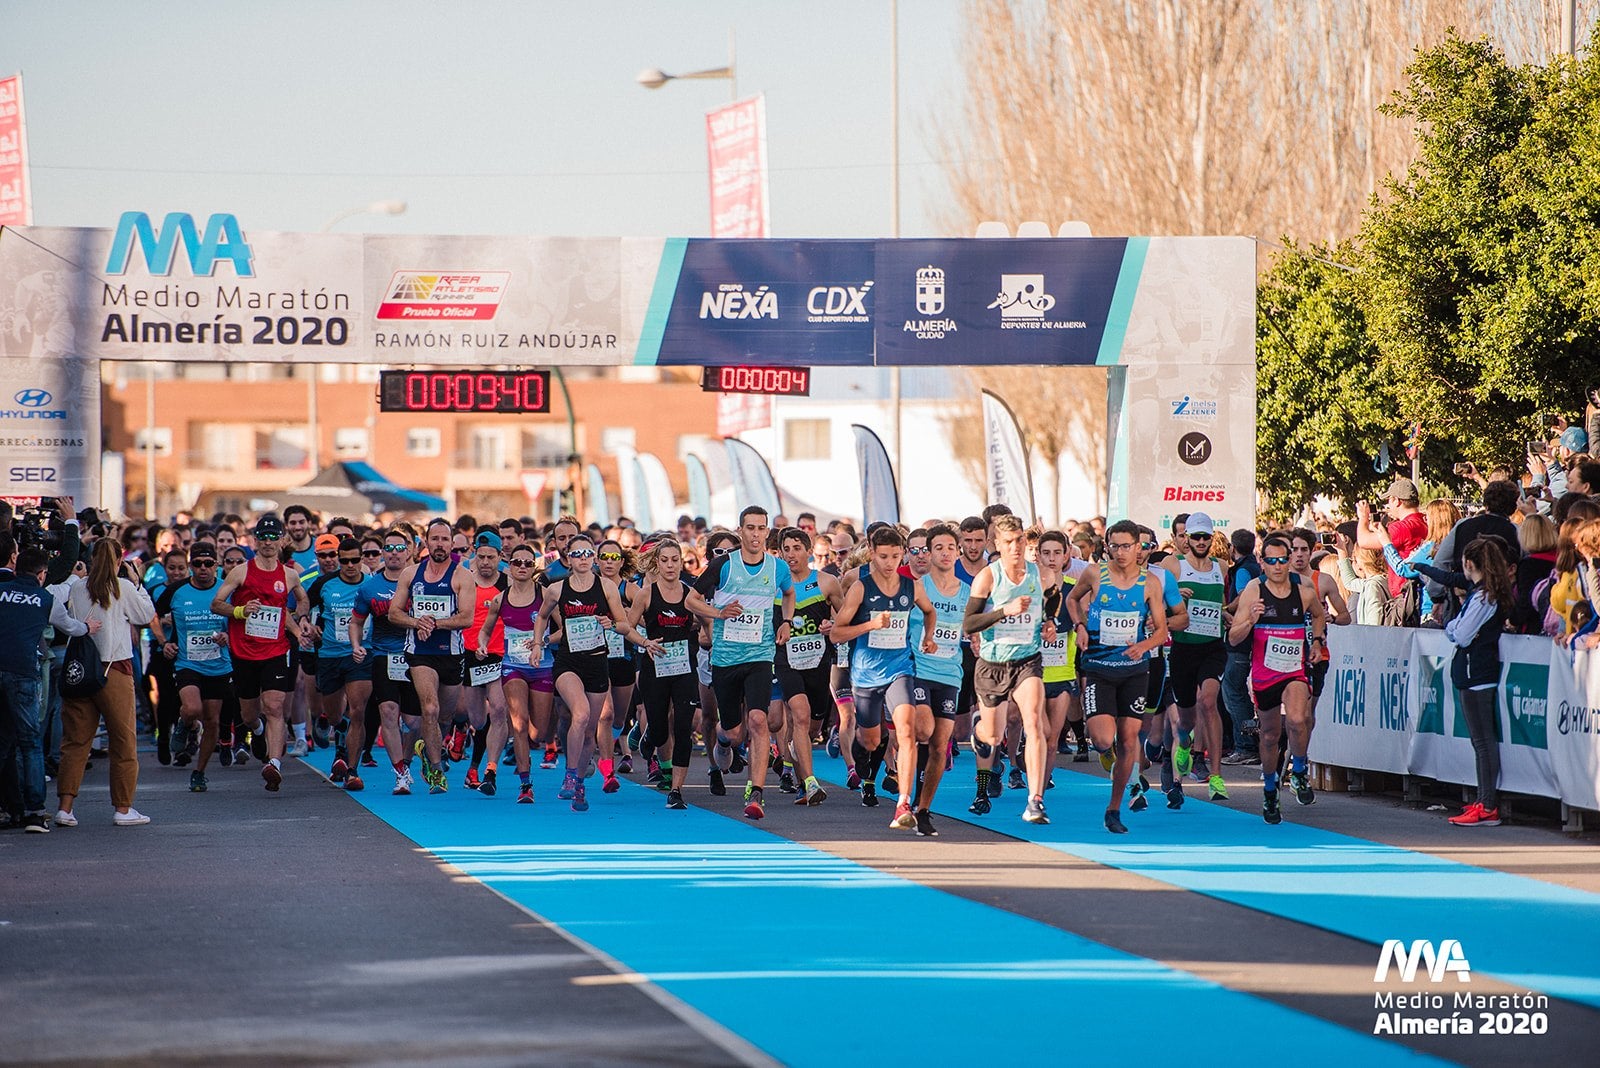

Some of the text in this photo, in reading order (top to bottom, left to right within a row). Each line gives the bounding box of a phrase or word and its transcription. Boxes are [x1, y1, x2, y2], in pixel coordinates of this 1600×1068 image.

[439, 275, 481, 285] RFEA
[102, 282, 350, 311] Medio Maratón
[700, 287, 779, 319] NEXA
[807, 281, 875, 315] CDX
[402, 307, 477, 317] Prueba Oficial
[101, 314, 348, 346] Almería 2020
[904, 318, 958, 332] ALMERÍA
[1001, 321, 1041, 329] DEPORTES
[1042, 321, 1053, 329] DE
[375, 330, 617, 349] RAMÓN RUIZ ANDÚJAR
[917, 332, 945, 340] CIUDAD
[0, 410, 67, 419] HYUNDAI
[10, 468, 57, 482] SER
[1163, 486, 1225, 502] Blanes
[0, 591, 41, 607] NEXA
[417, 602, 445, 611] 5601
[931, 601, 958, 613] erja
[1192, 606, 1219, 619] 5472
[251, 609, 277, 622] 5111
[571, 620, 599, 634] 5847
[1105, 617, 1136, 628] 6109
[932, 628, 958, 640] 965
[665, 646, 686, 659] 582
[791, 640, 822, 653] 5688
[1272, 644, 1300, 655] 6088
[392, 656, 406, 664] 50
[475, 662, 502, 676] 5922
[1333, 668, 1365, 727] NEXA
